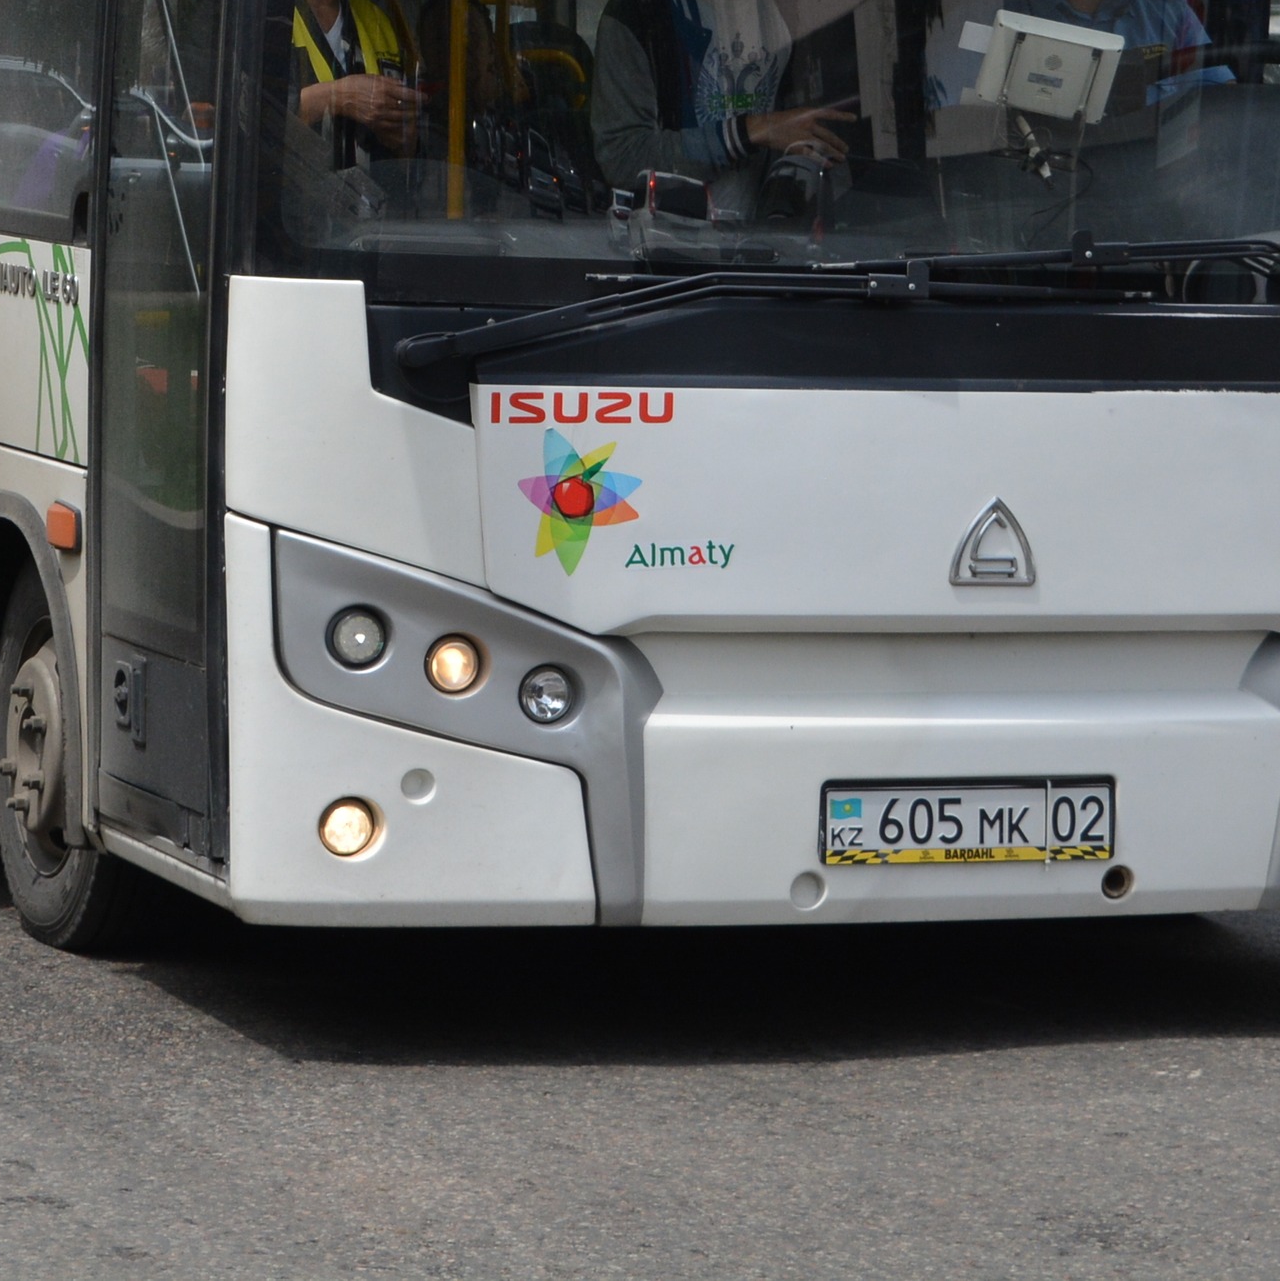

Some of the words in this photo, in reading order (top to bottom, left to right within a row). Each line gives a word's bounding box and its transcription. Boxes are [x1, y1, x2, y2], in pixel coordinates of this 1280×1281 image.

[42, 268, 60, 304] LE
[490, 391, 674, 424] ISUZU
[625, 539, 735, 569] Almaty
[878, 798, 964, 845] 605
[978, 807, 1030, 845] MK
[1051, 795, 1105, 843] 02
[830, 826, 864, 847] KZ
[944, 848, 996, 862] BARDAHL
